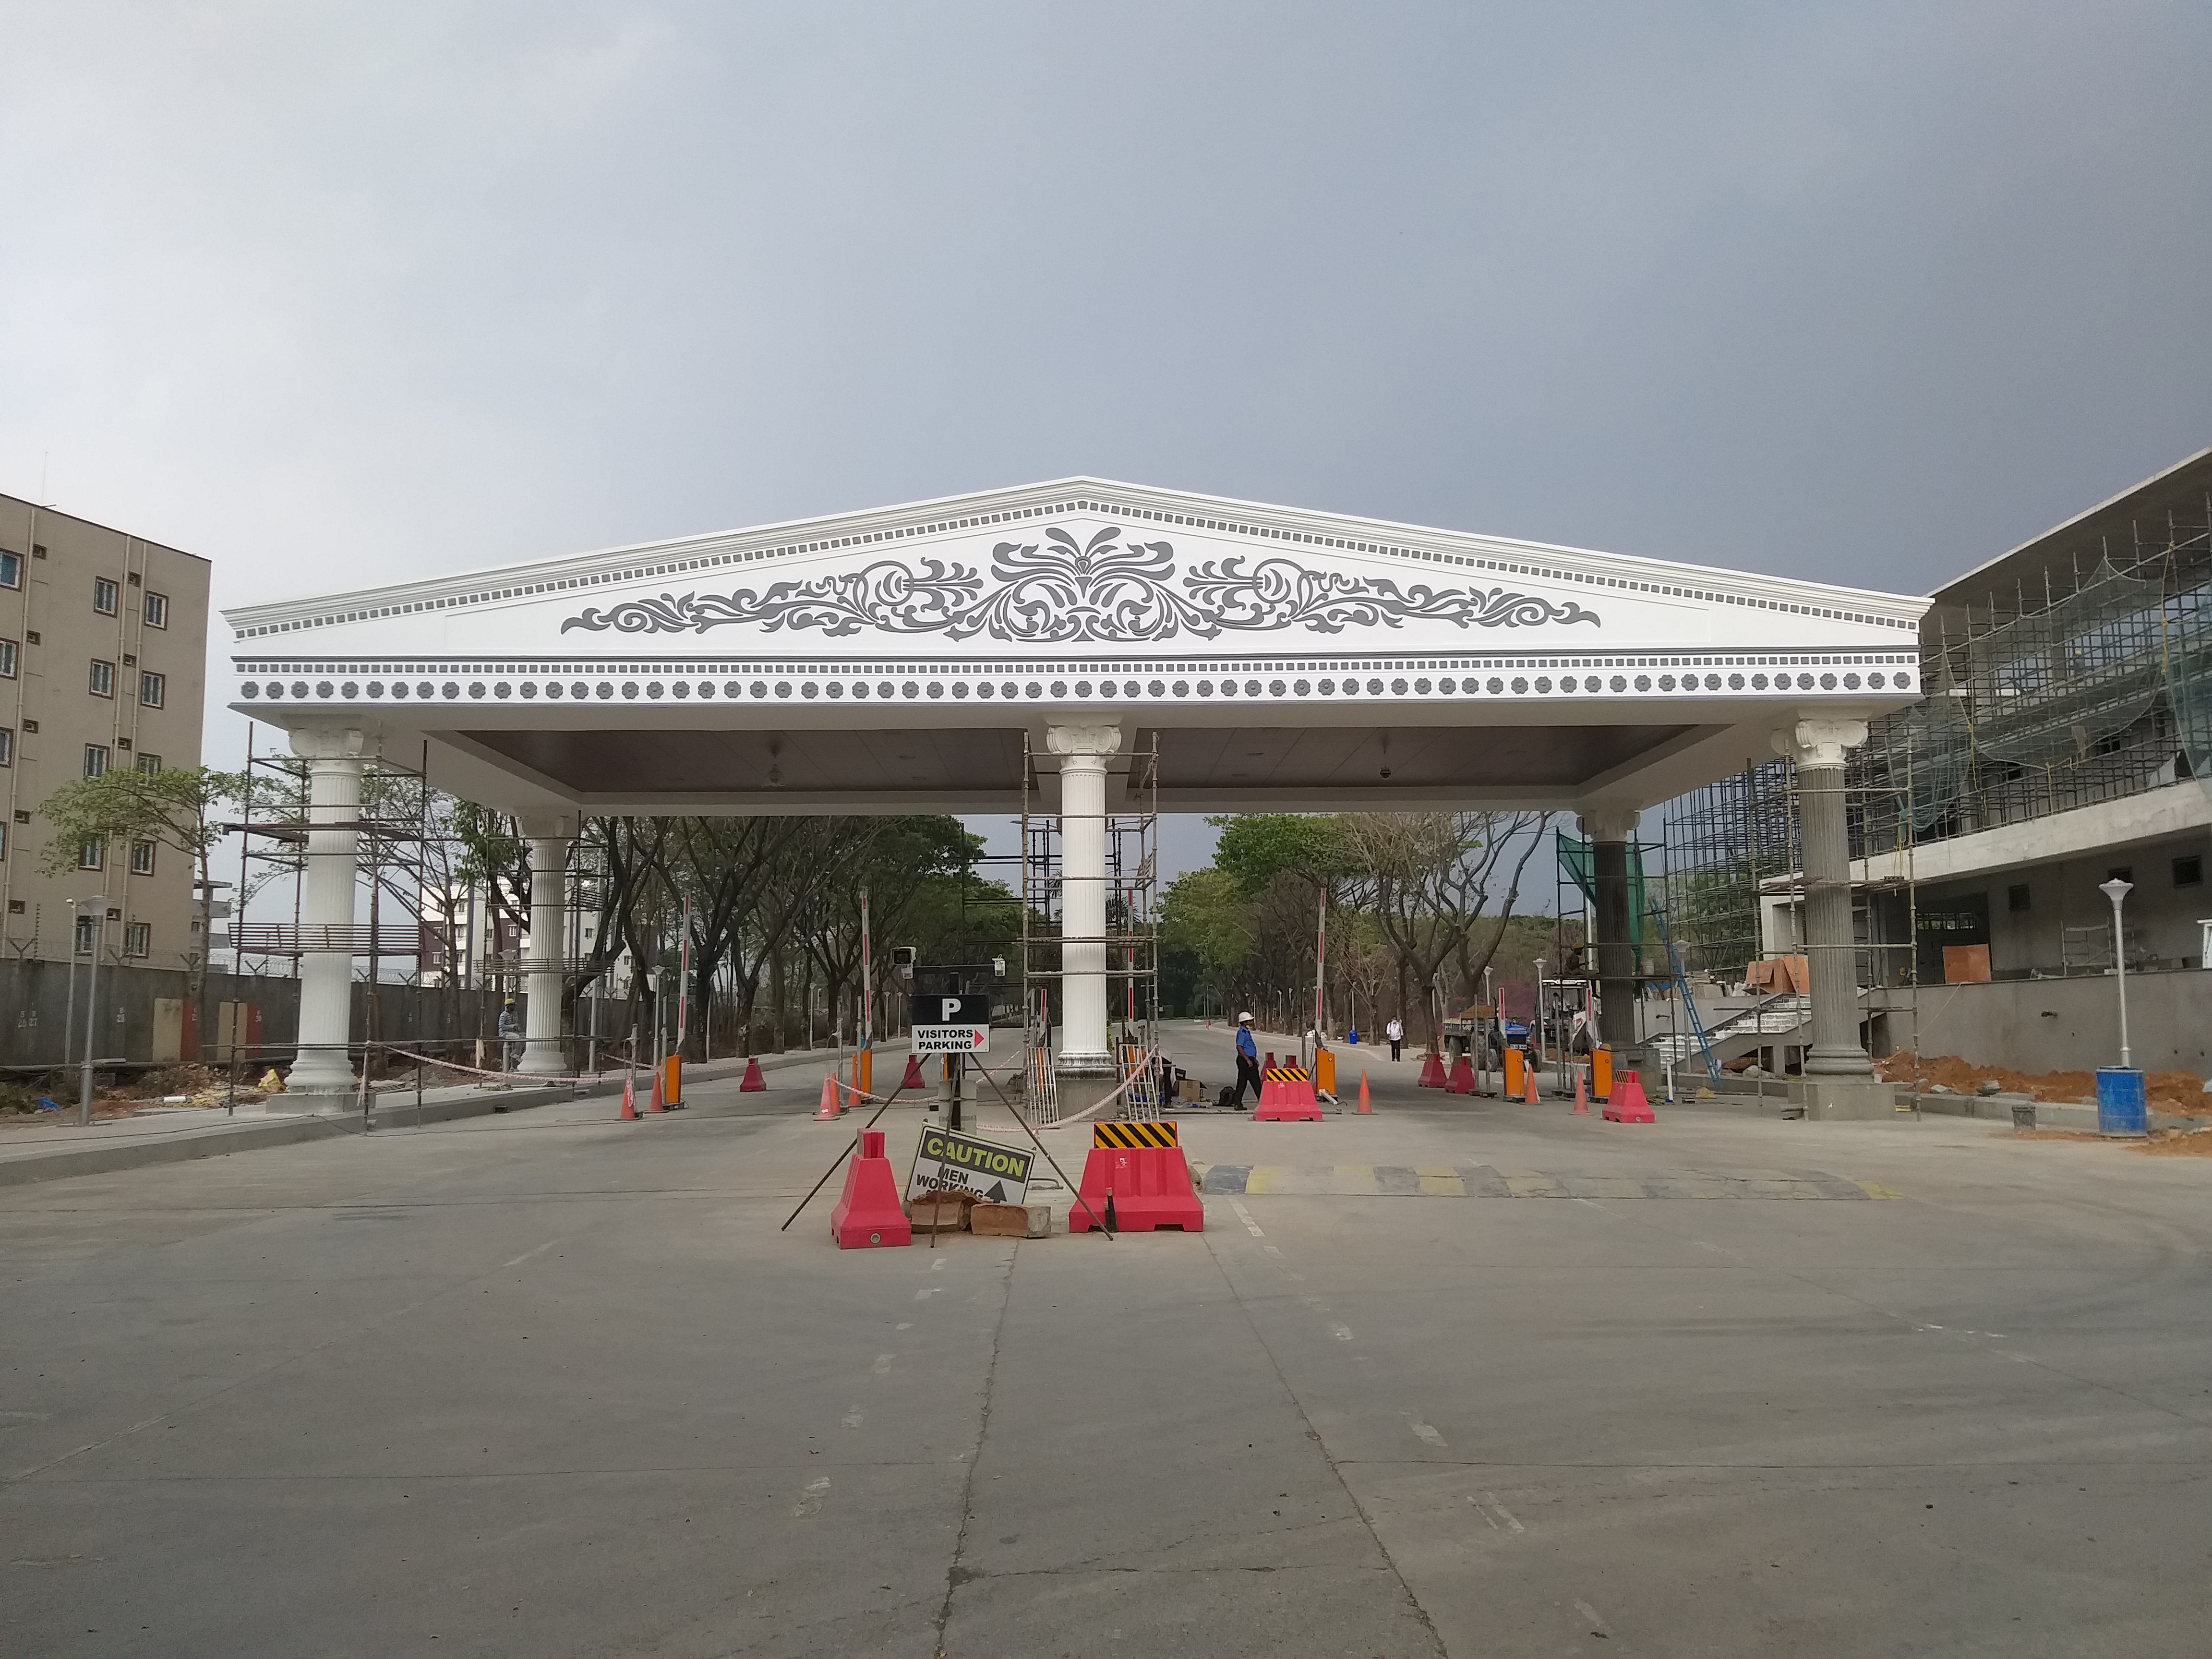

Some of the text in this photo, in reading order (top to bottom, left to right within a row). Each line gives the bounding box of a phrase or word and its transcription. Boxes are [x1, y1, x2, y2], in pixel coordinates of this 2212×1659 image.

[942, 998, 961, 1022] P
[917, 1030, 973, 1038] VISITORS
[919, 1041, 972, 1050] PARKING
[927, 1138, 1025, 1177] CAUTION
[916, 1174, 984, 1198] WORKNG
[938, 1166, 969, 1185] MEN
